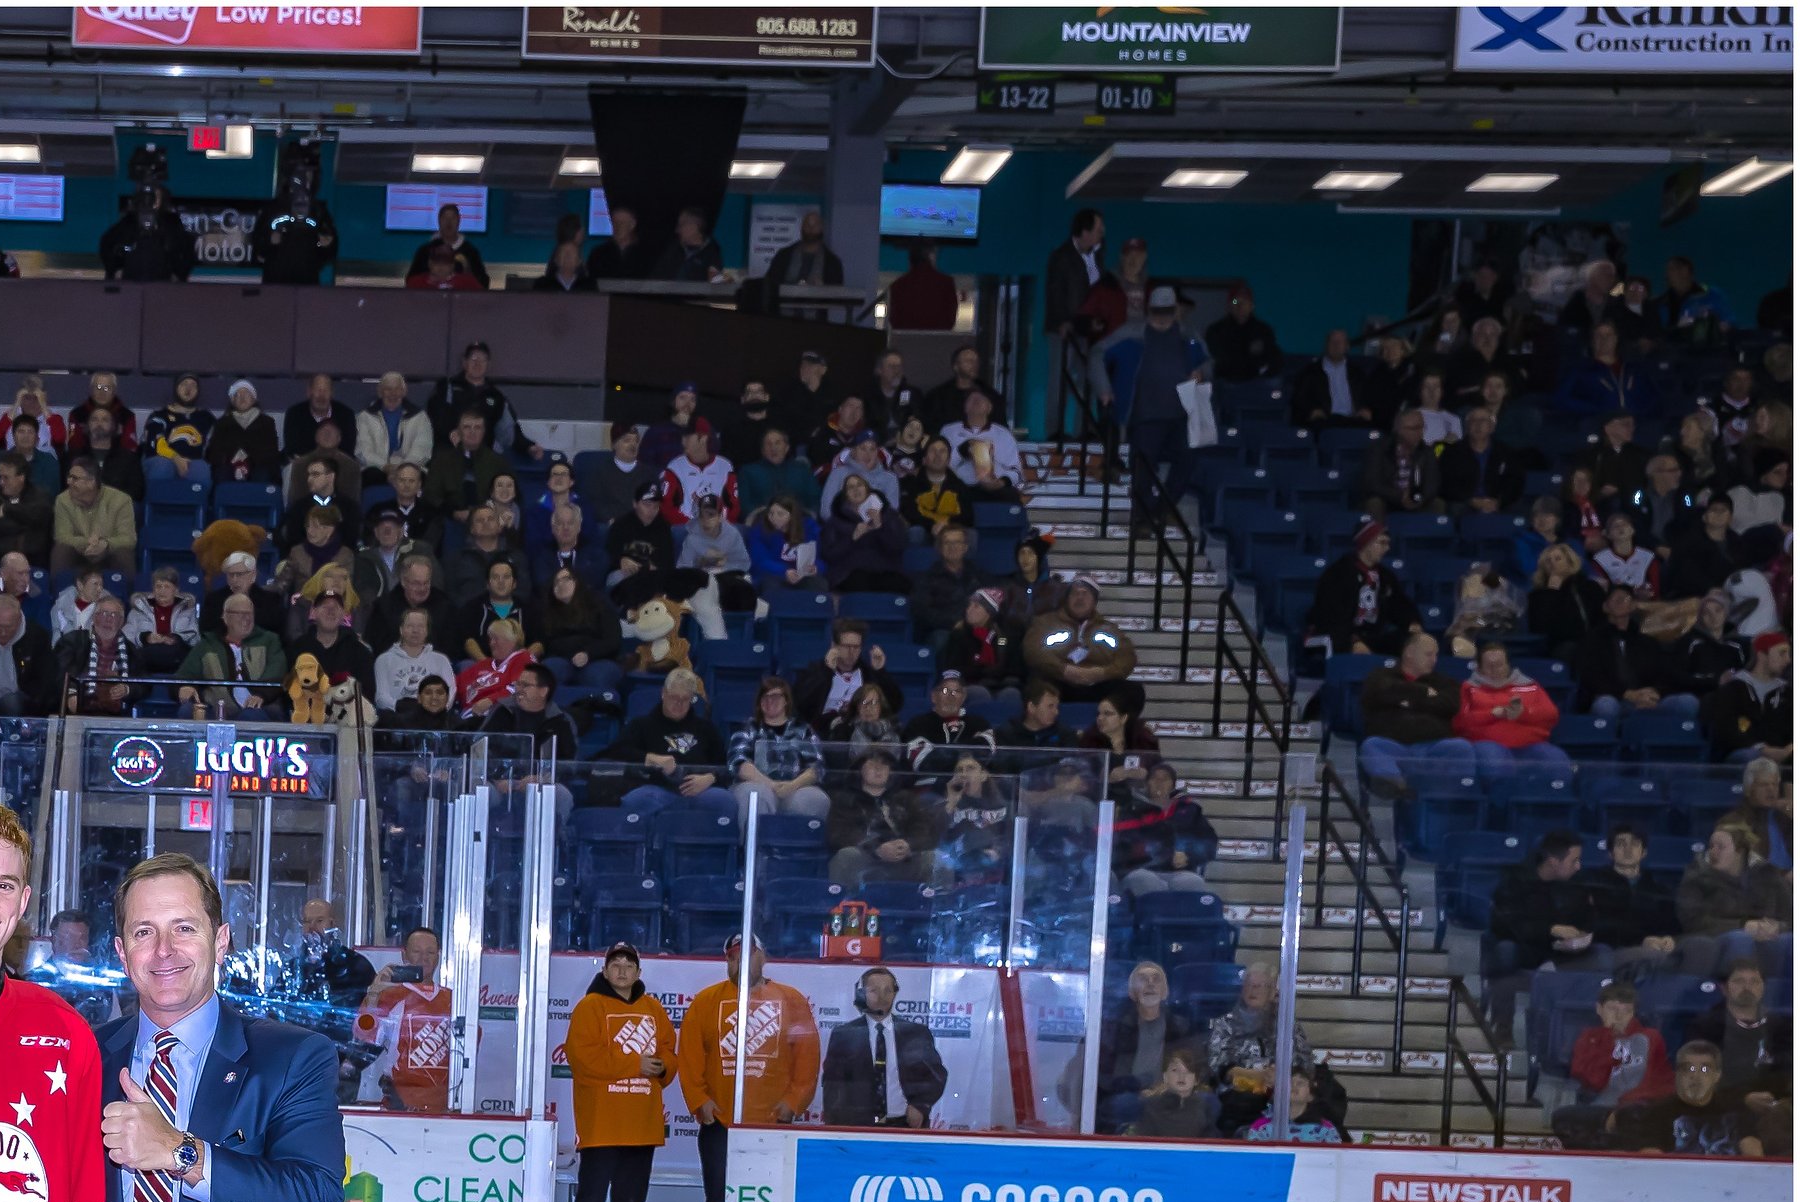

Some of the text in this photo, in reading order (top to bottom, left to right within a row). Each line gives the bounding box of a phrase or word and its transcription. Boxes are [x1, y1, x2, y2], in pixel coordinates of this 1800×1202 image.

[216, 7, 362, 26] Low Prices!
[562, 7, 641, 33] Rinaldi
[1061, 22, 1251, 43] MOUNTAINVIEW
[1575, 31, 1752, 53] Construction
[589, 39, 640, 48] HOMES
[1118, 49, 1188, 61] HOMES
[999, 86, 1050, 109] 13-22
[1101, 86, 1152, 109] 01-10
[188, 800, 213, 827] EX
[901, 1015, 972, 1030] TOPPERS
[19, 1034, 71, 1050] CCM
[469, 1133, 526, 1163] CO
